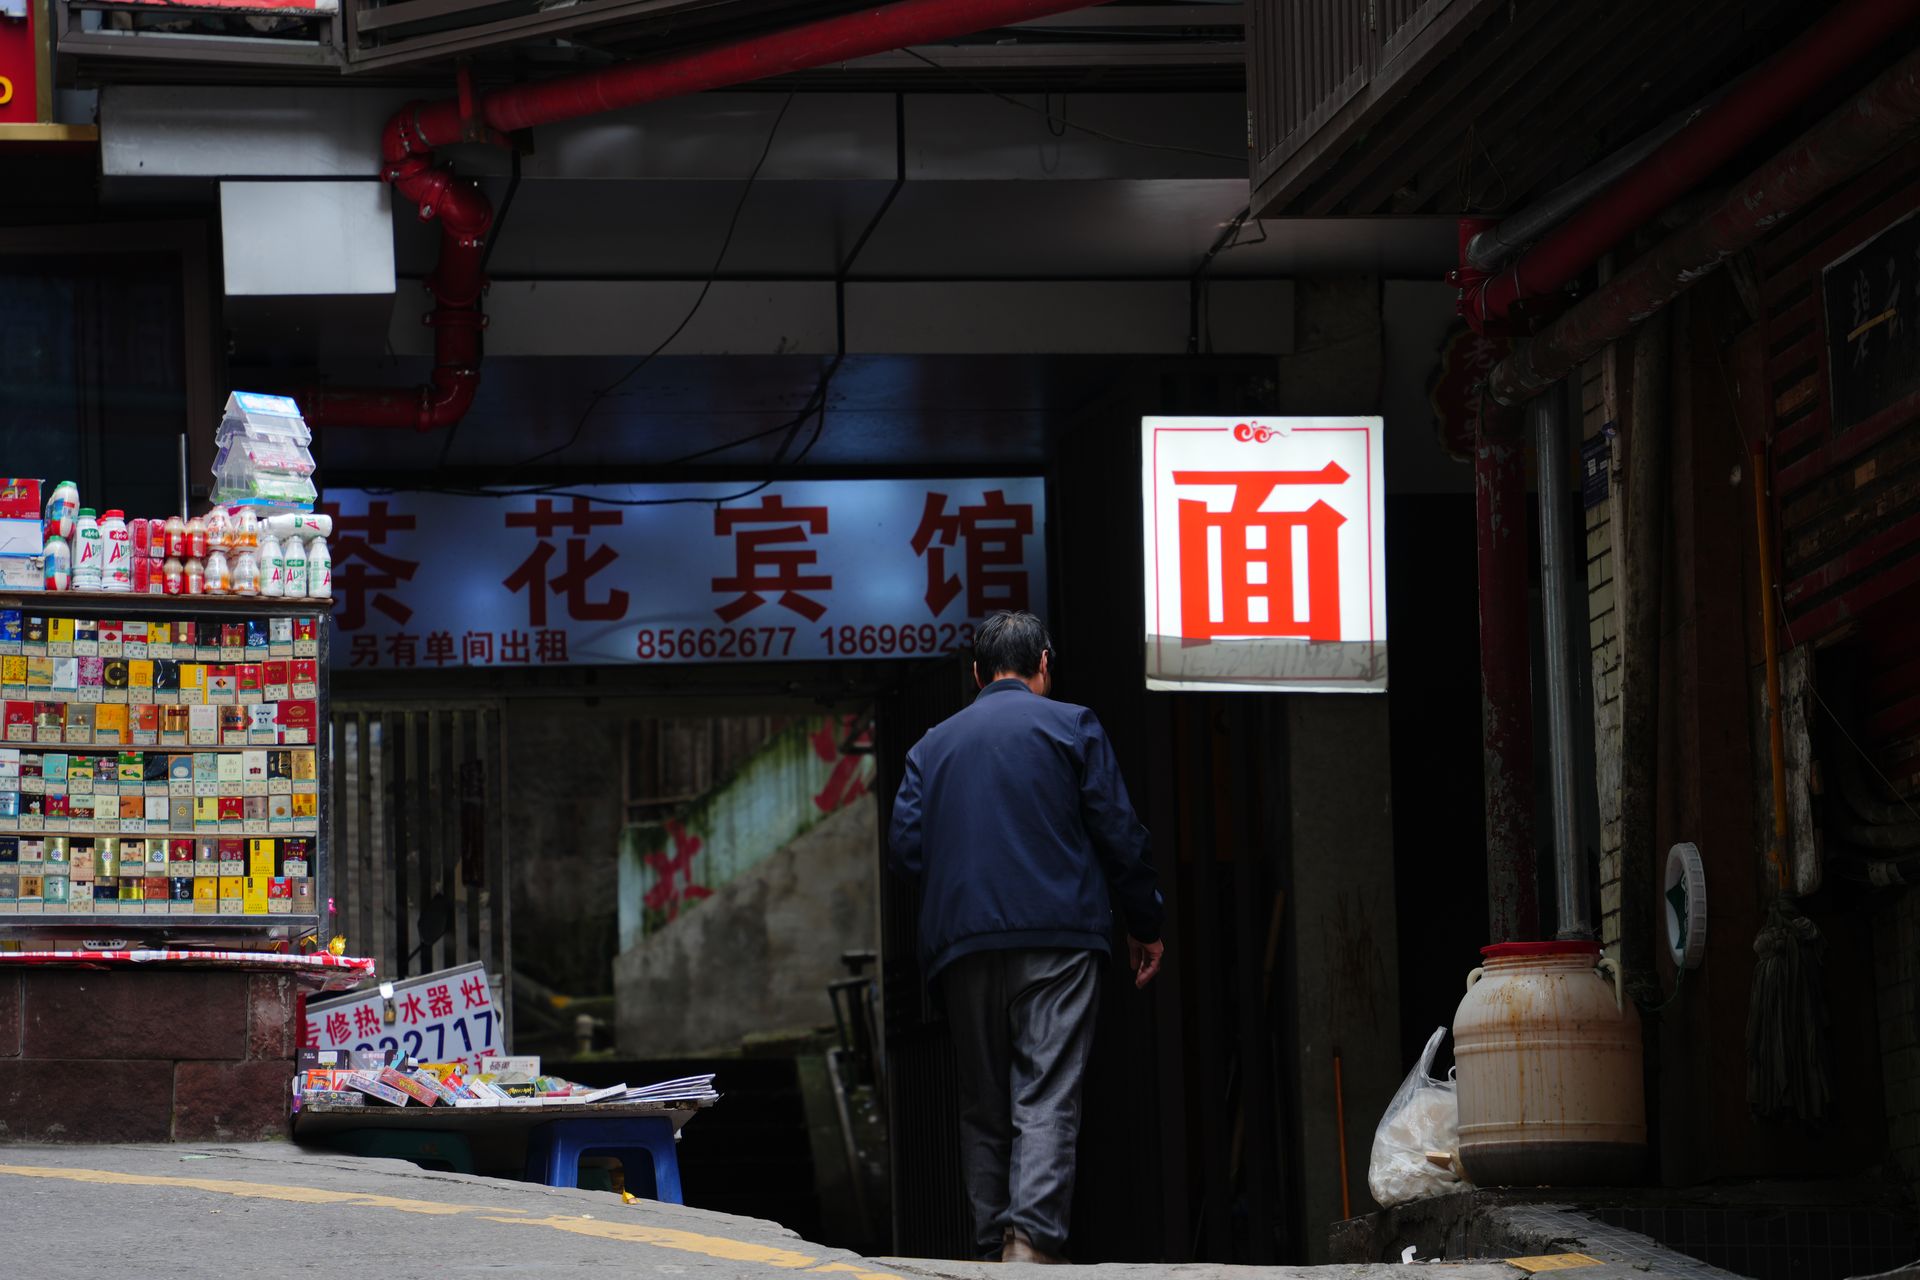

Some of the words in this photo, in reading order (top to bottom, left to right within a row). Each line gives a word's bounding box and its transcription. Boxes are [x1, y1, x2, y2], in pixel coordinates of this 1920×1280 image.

[323, 489, 1033, 631] 茶花宾馆
[1172, 460, 1350, 649] 面
[350, 628, 569, 668] 另有单间出租
[636, 626, 797, 659] 85662677
[354, 1010, 493, 1064] 2717
